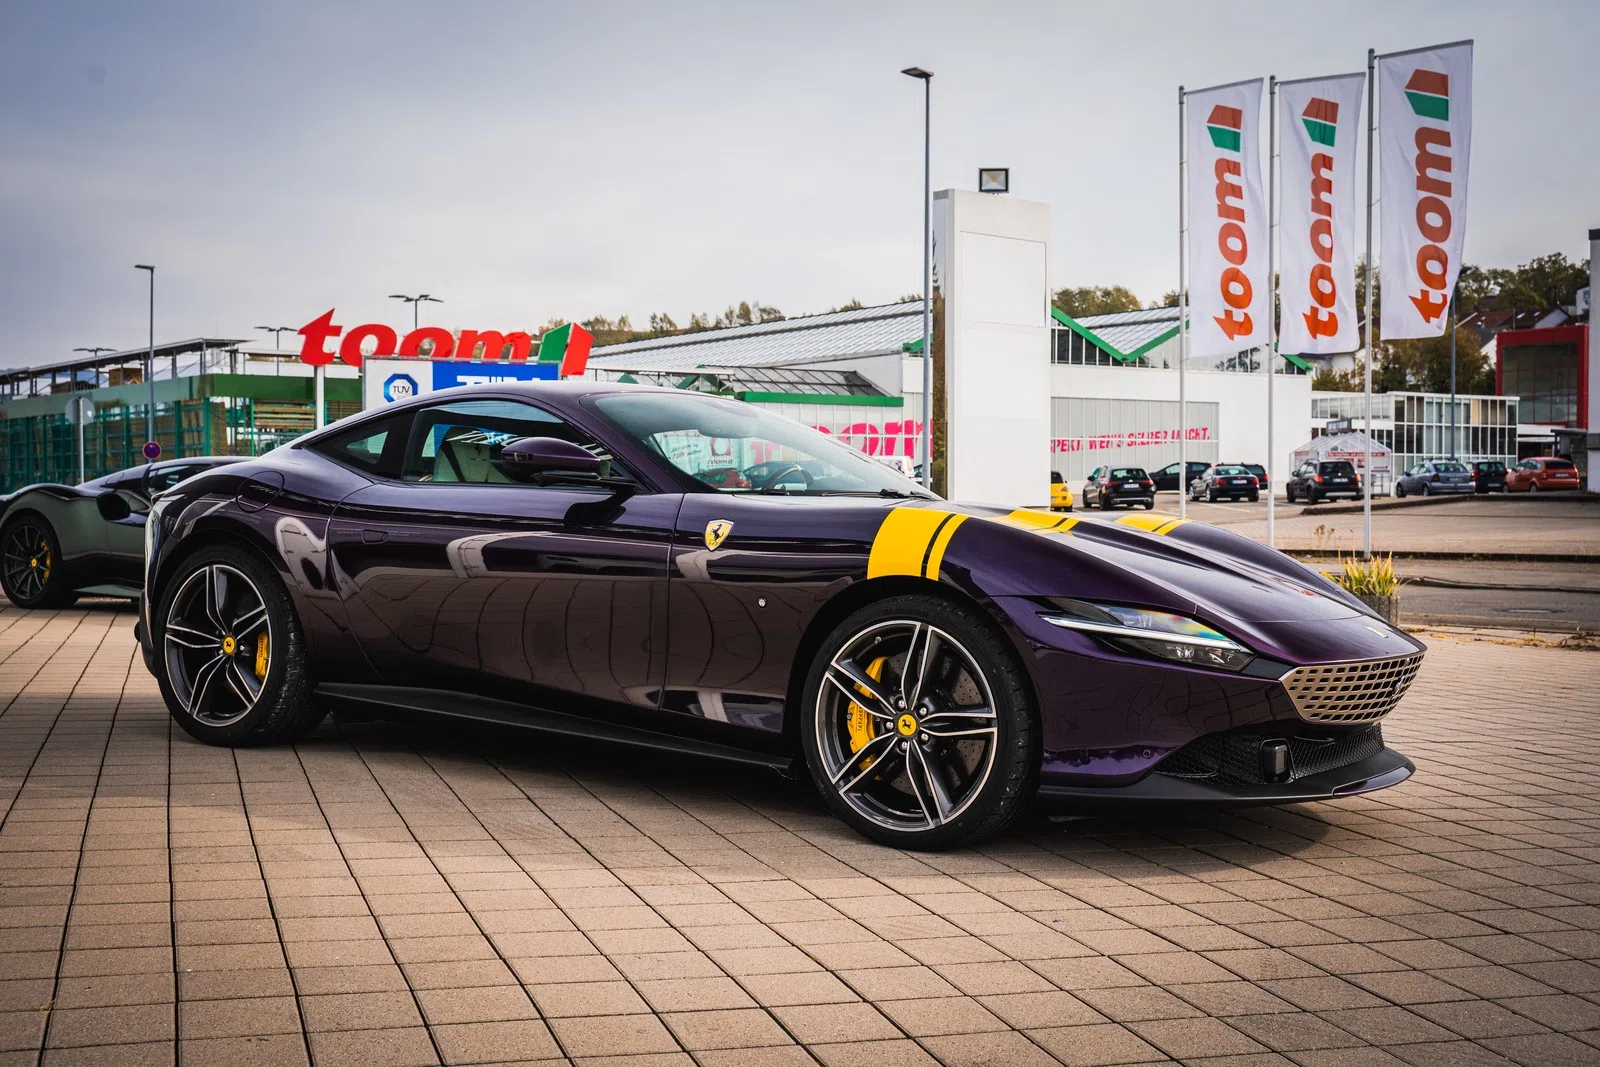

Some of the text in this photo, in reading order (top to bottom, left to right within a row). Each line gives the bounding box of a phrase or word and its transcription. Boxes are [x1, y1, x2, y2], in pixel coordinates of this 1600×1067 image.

[1212, 157, 1254, 341] toom
[1302, 152, 1339, 340] toom
[1408, 126, 1452, 324] toom
[297, 308, 532, 367] toom
